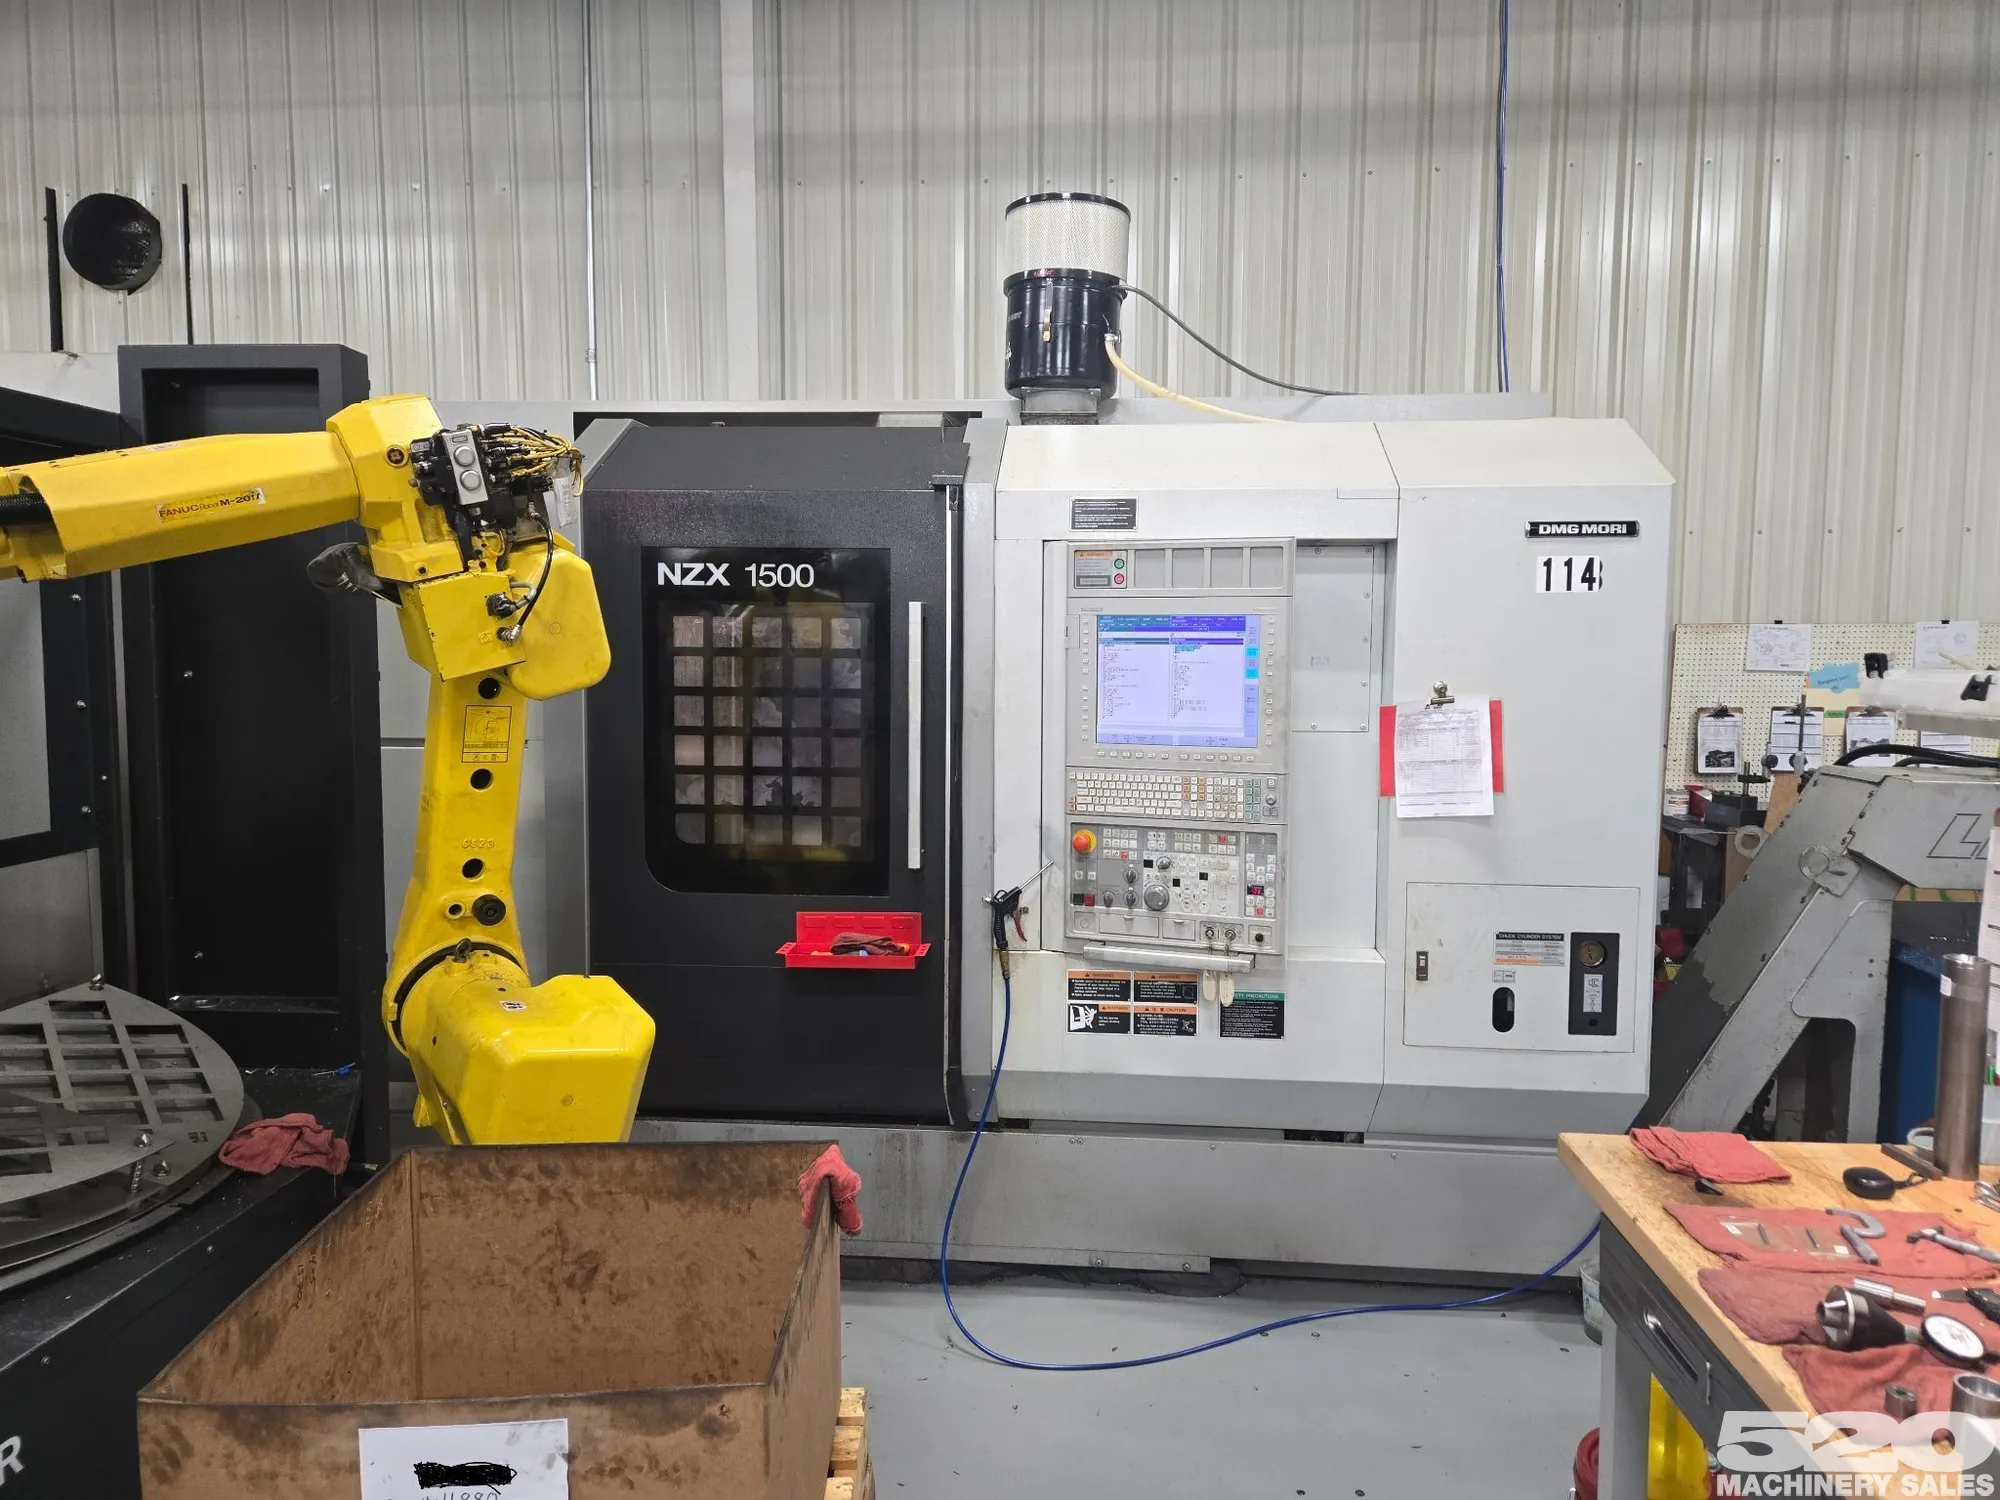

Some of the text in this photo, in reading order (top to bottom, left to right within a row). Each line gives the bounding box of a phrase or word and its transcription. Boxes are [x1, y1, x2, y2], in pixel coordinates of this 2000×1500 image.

[160, 504, 199, 518] FANUC
[1539, 524, 1627, 534] DMG MORI
[657, 562, 815, 588] NZX 1500
